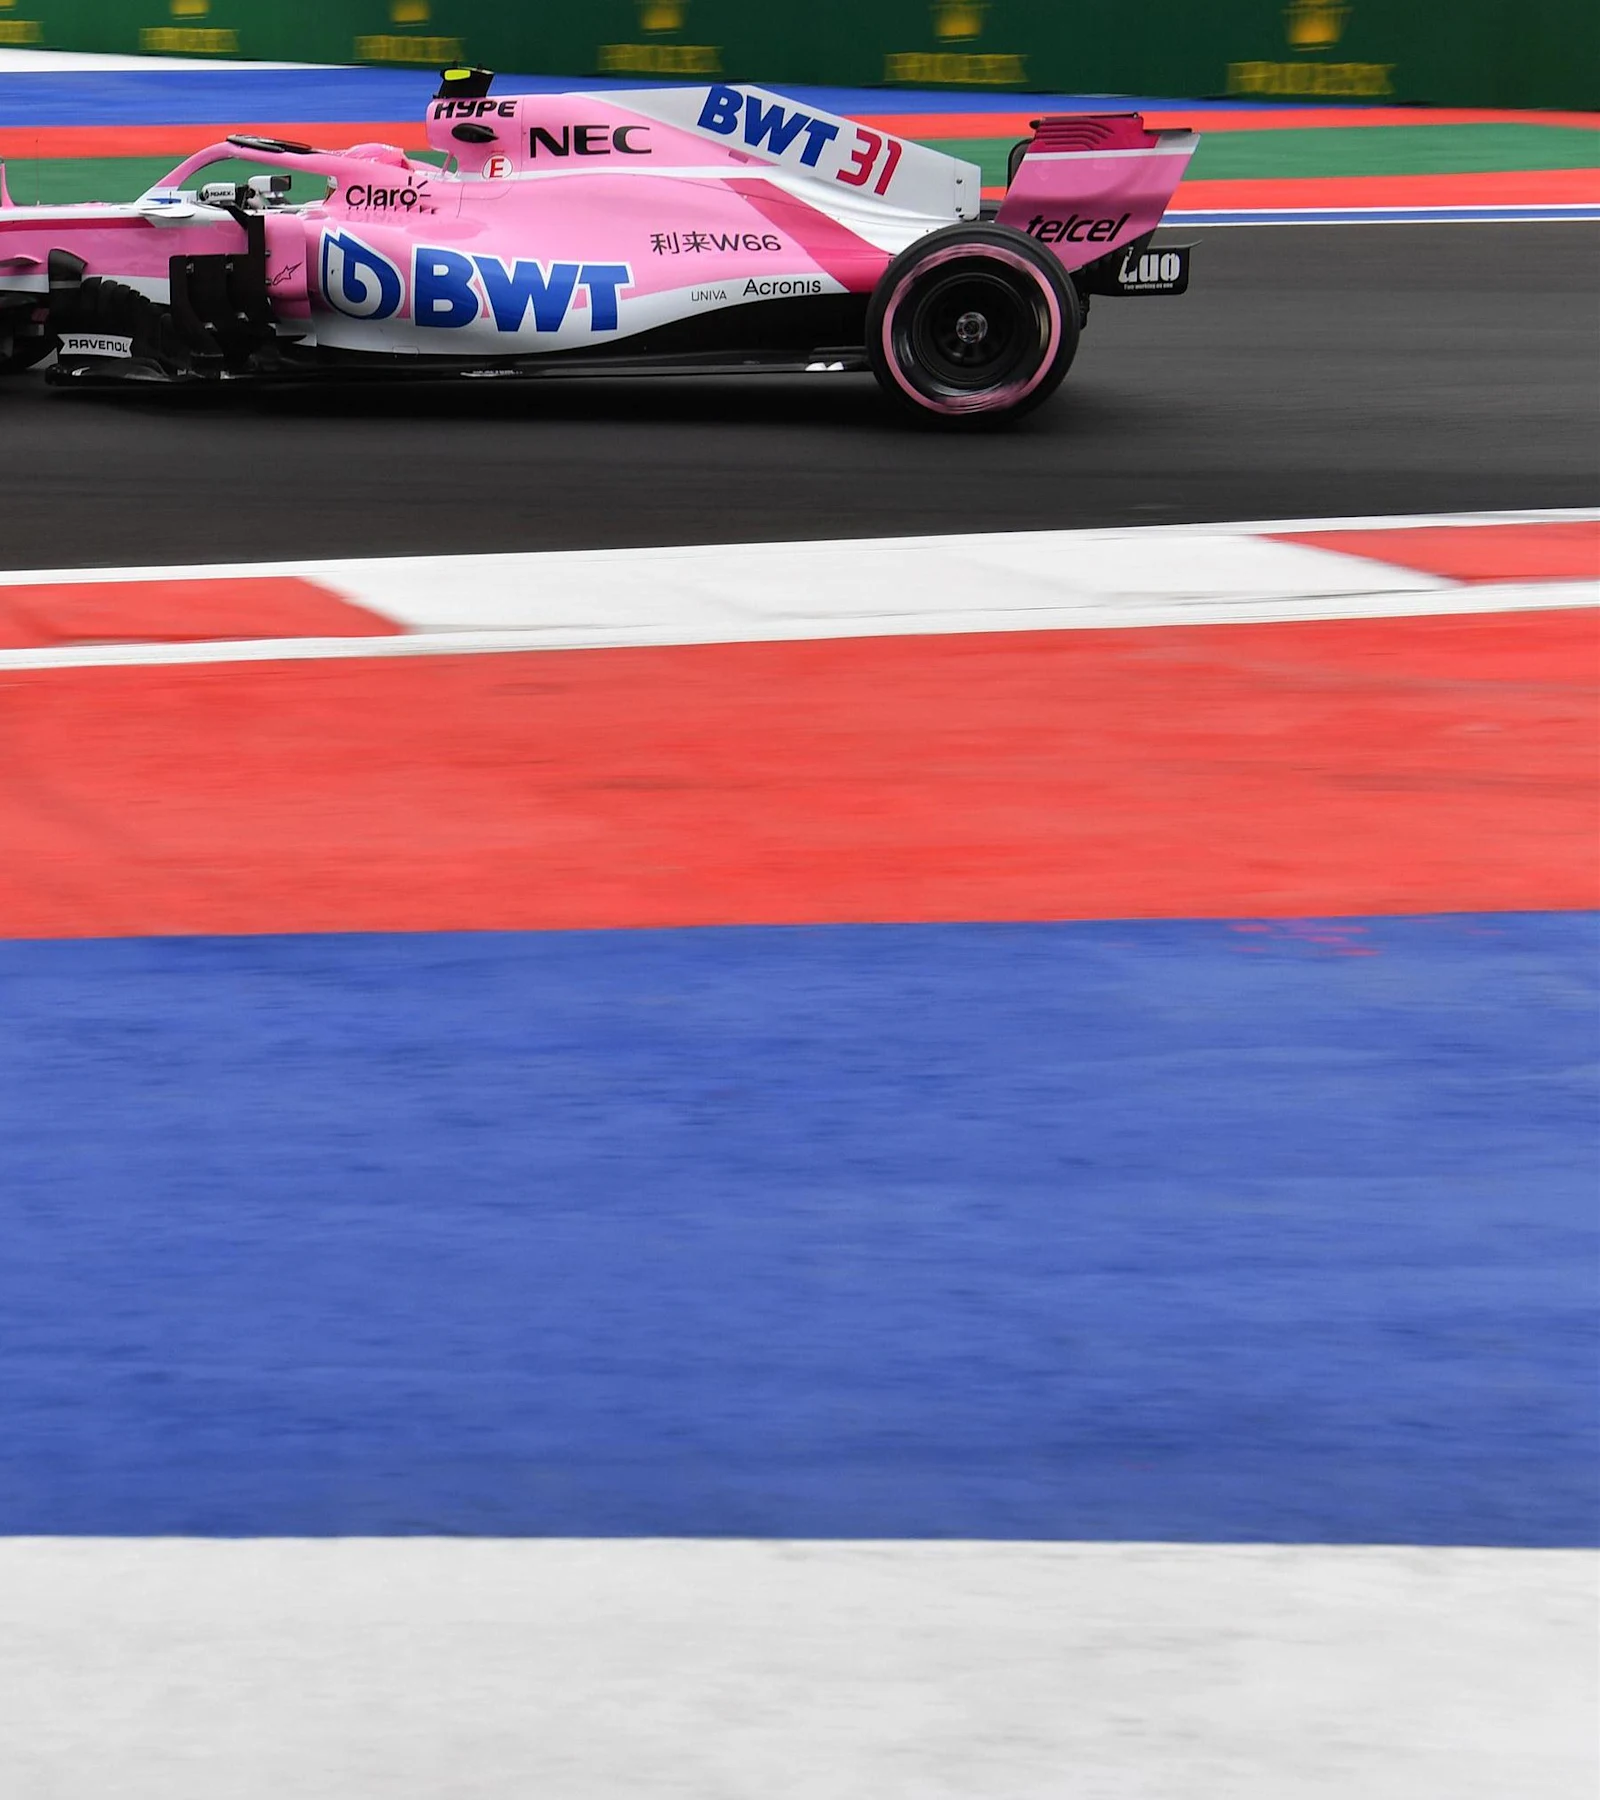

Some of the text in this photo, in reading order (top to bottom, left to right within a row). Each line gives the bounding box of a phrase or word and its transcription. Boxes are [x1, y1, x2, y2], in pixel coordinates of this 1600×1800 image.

[434, 101, 518, 120] HYPE
[530, 125, 652, 158] NEC
[697, 85, 903, 196] BWT 31
[346, 185, 418, 207] Claro
[1025, 213, 1132, 243] telcel
[650, 231, 782, 255] 利来W66
[415, 247, 630, 333] BWT
[691, 290, 727, 302] UNIVA
[742, 278, 821, 297] Acronis
[69, 339, 128, 353] RAVENOL
